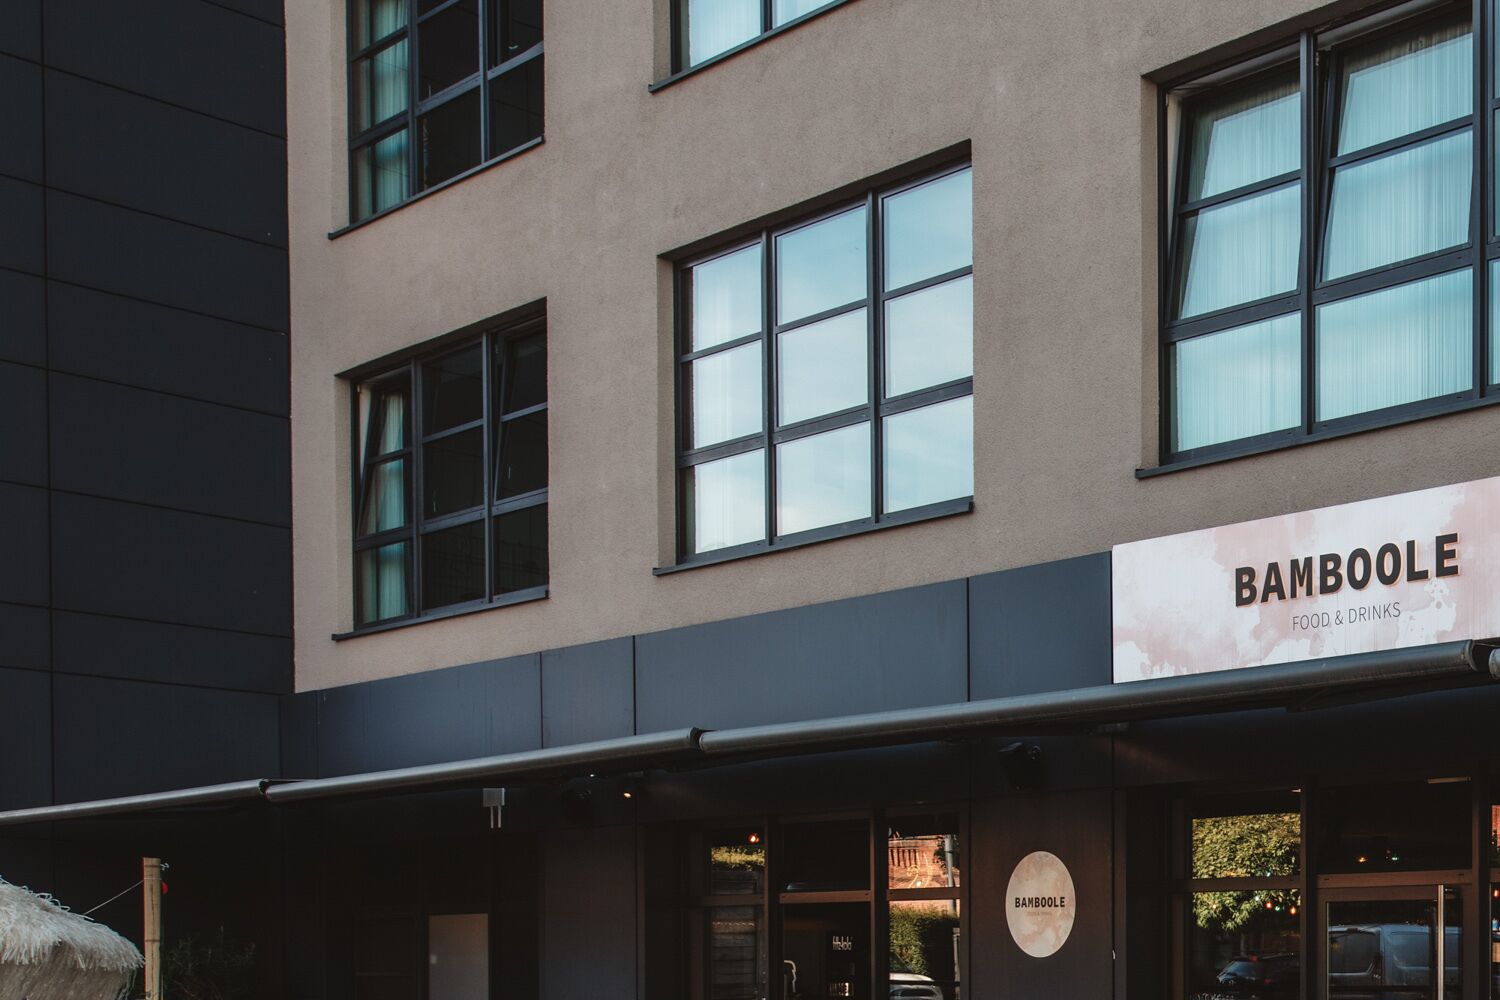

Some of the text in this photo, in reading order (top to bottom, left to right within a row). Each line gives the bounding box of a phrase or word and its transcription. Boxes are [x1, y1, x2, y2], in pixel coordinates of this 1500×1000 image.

[1235, 532, 1460, 607] BAMBOOLE
[1292, 601, 1402, 631] FOOD & DRINKS
[1014, 896, 1066, 908] BAMBOOLE
